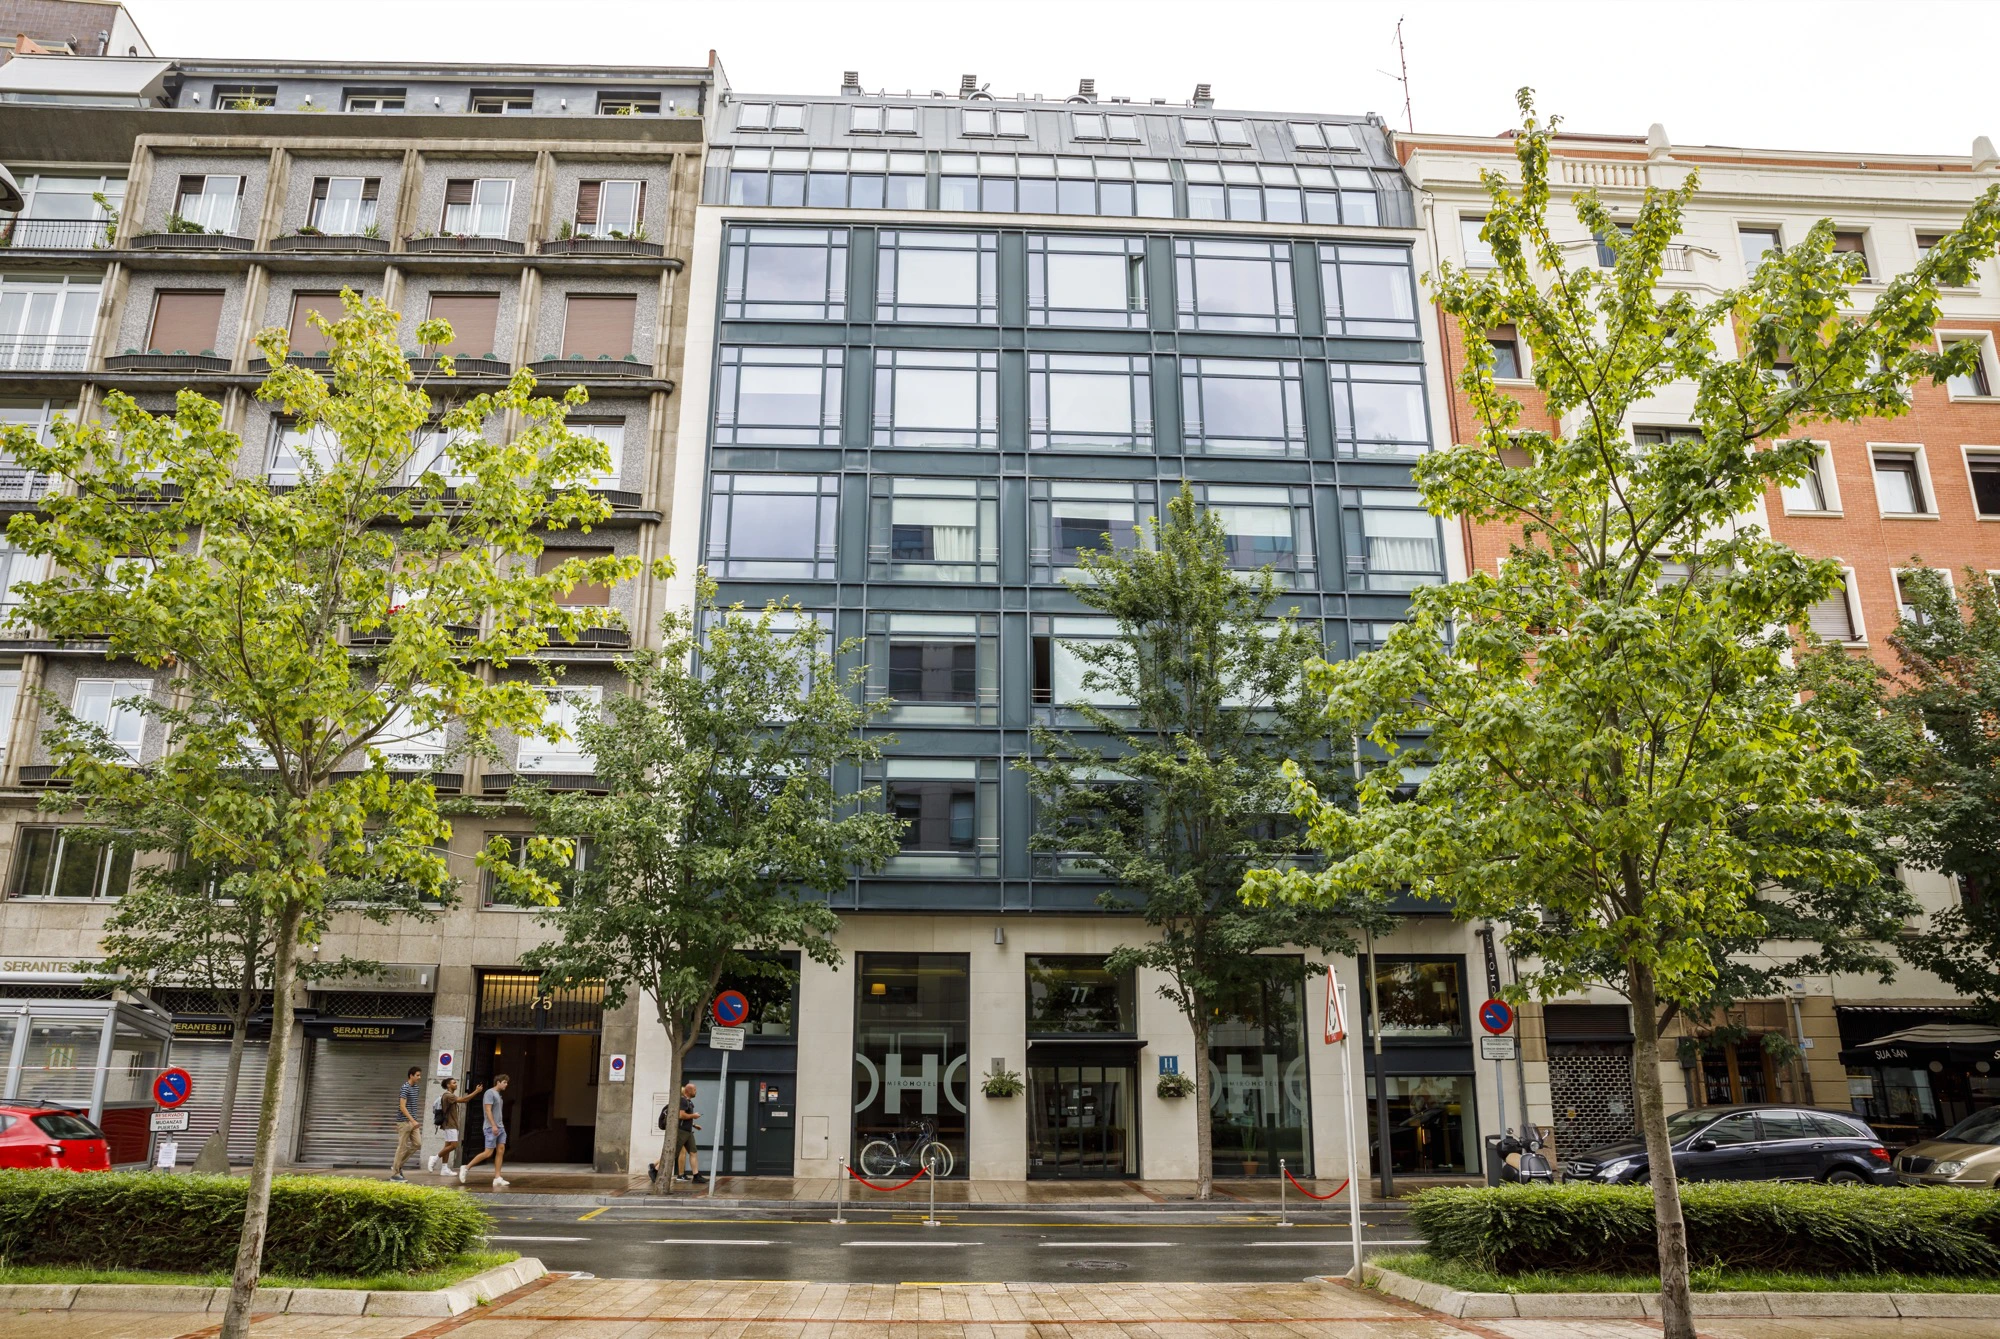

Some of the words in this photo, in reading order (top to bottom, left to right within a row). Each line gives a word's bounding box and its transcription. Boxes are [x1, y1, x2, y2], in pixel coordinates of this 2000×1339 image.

[1070, 986, 1089, 1003] 77
[530, 992, 553, 1010] 75
[174, 1022, 217, 1031] ERANTES
[333, 1026, 380, 1035] SERANTES
[1875, 1050, 1892, 1060] SUA
[1891, 1048, 1908, 1058] SAN
